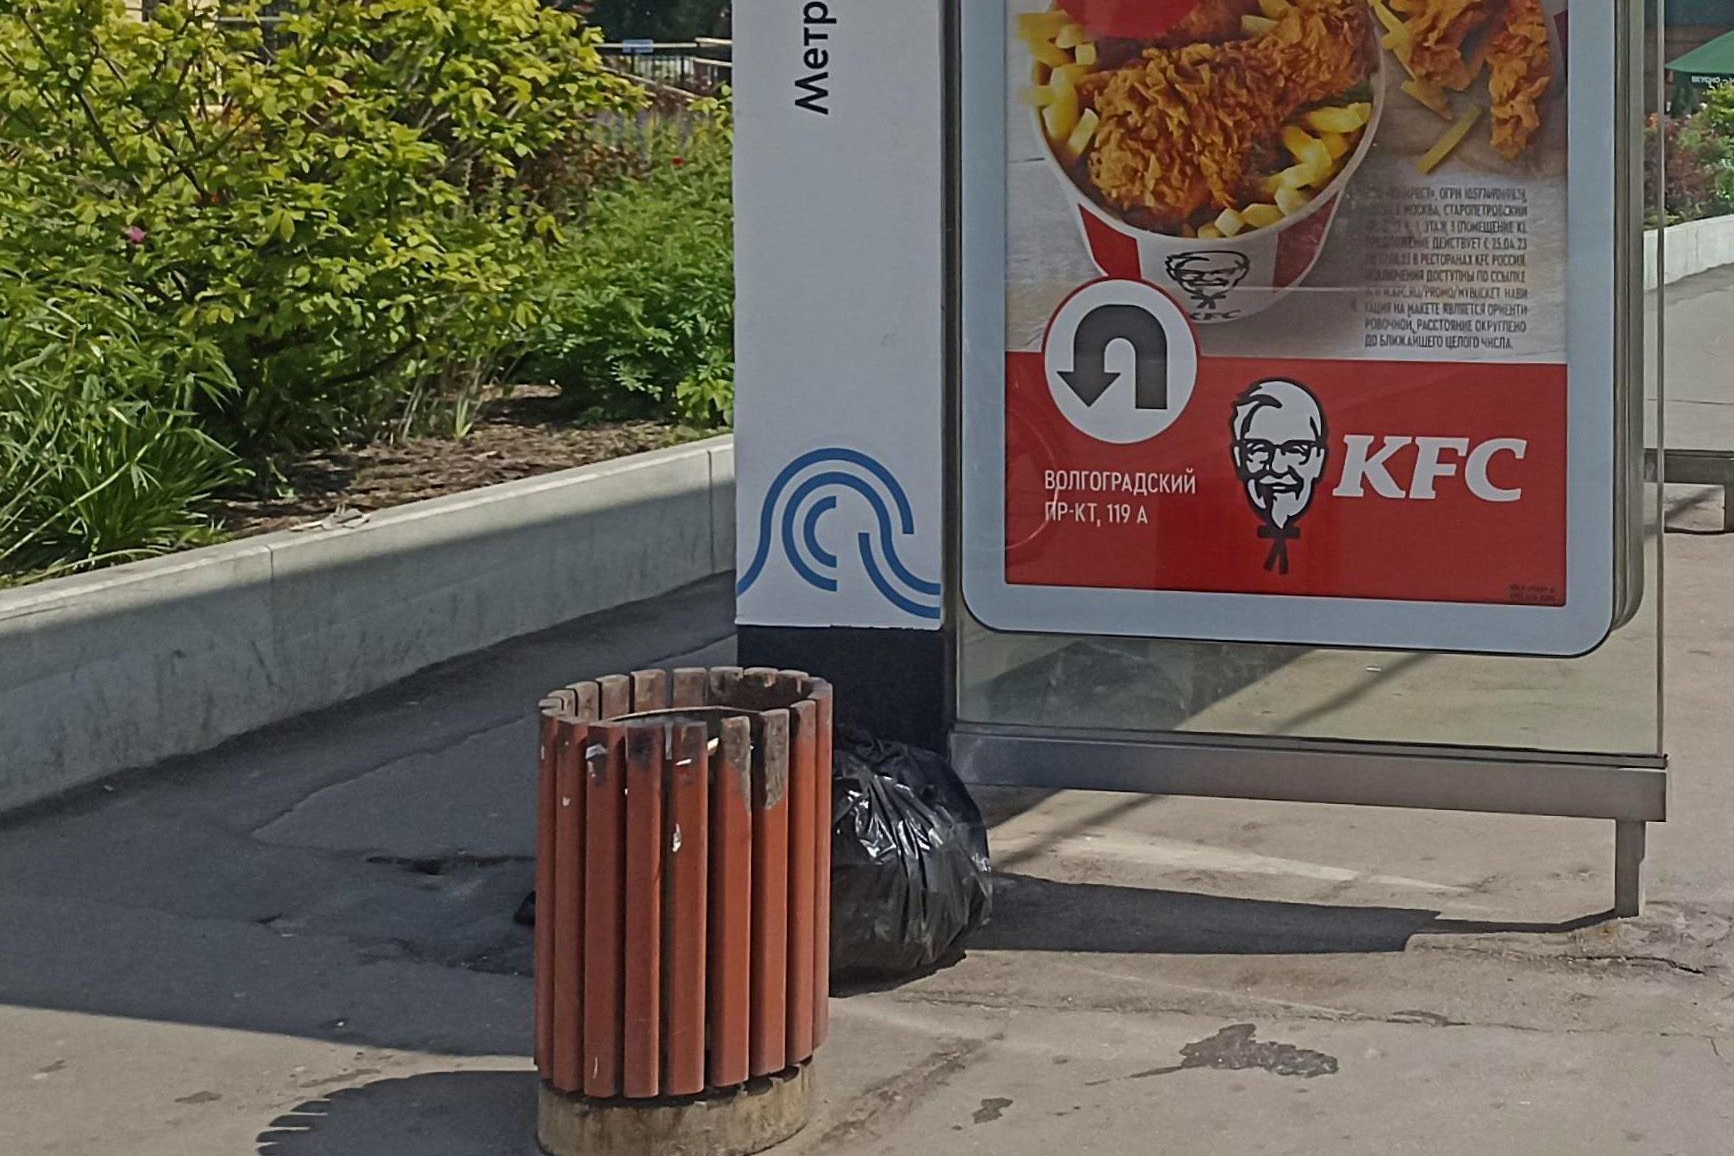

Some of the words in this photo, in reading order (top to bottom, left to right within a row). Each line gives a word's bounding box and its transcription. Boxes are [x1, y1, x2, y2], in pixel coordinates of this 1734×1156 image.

[1426, 270, 1475, 284] ДОСТУПНЫ
[1477, 271, 1489, 284] ПО
[1490, 271, 1526, 285] ССЫЛКЕ
[1393, 302, 1405, 315] НА
[1416, 319, 1473, 332] РАССТОЯНИЕ
[1474, 319, 1527, 333] ОКРУГЛЕНО
[1364, 334, 1378, 349] ДО
[1379, 335, 1444, 349] БЛИЖАЙШЕГО
[1445, 335, 1480, 350] ЦЕЛОГО
[1331, 434, 1528, 504] KFC
[1044, 467, 1197, 497] ВОЛГОГРАДСКИЙ
[1044, 502, 1102, 529] ПР-КТ,
[1106, 503, 1132, 526] 119
